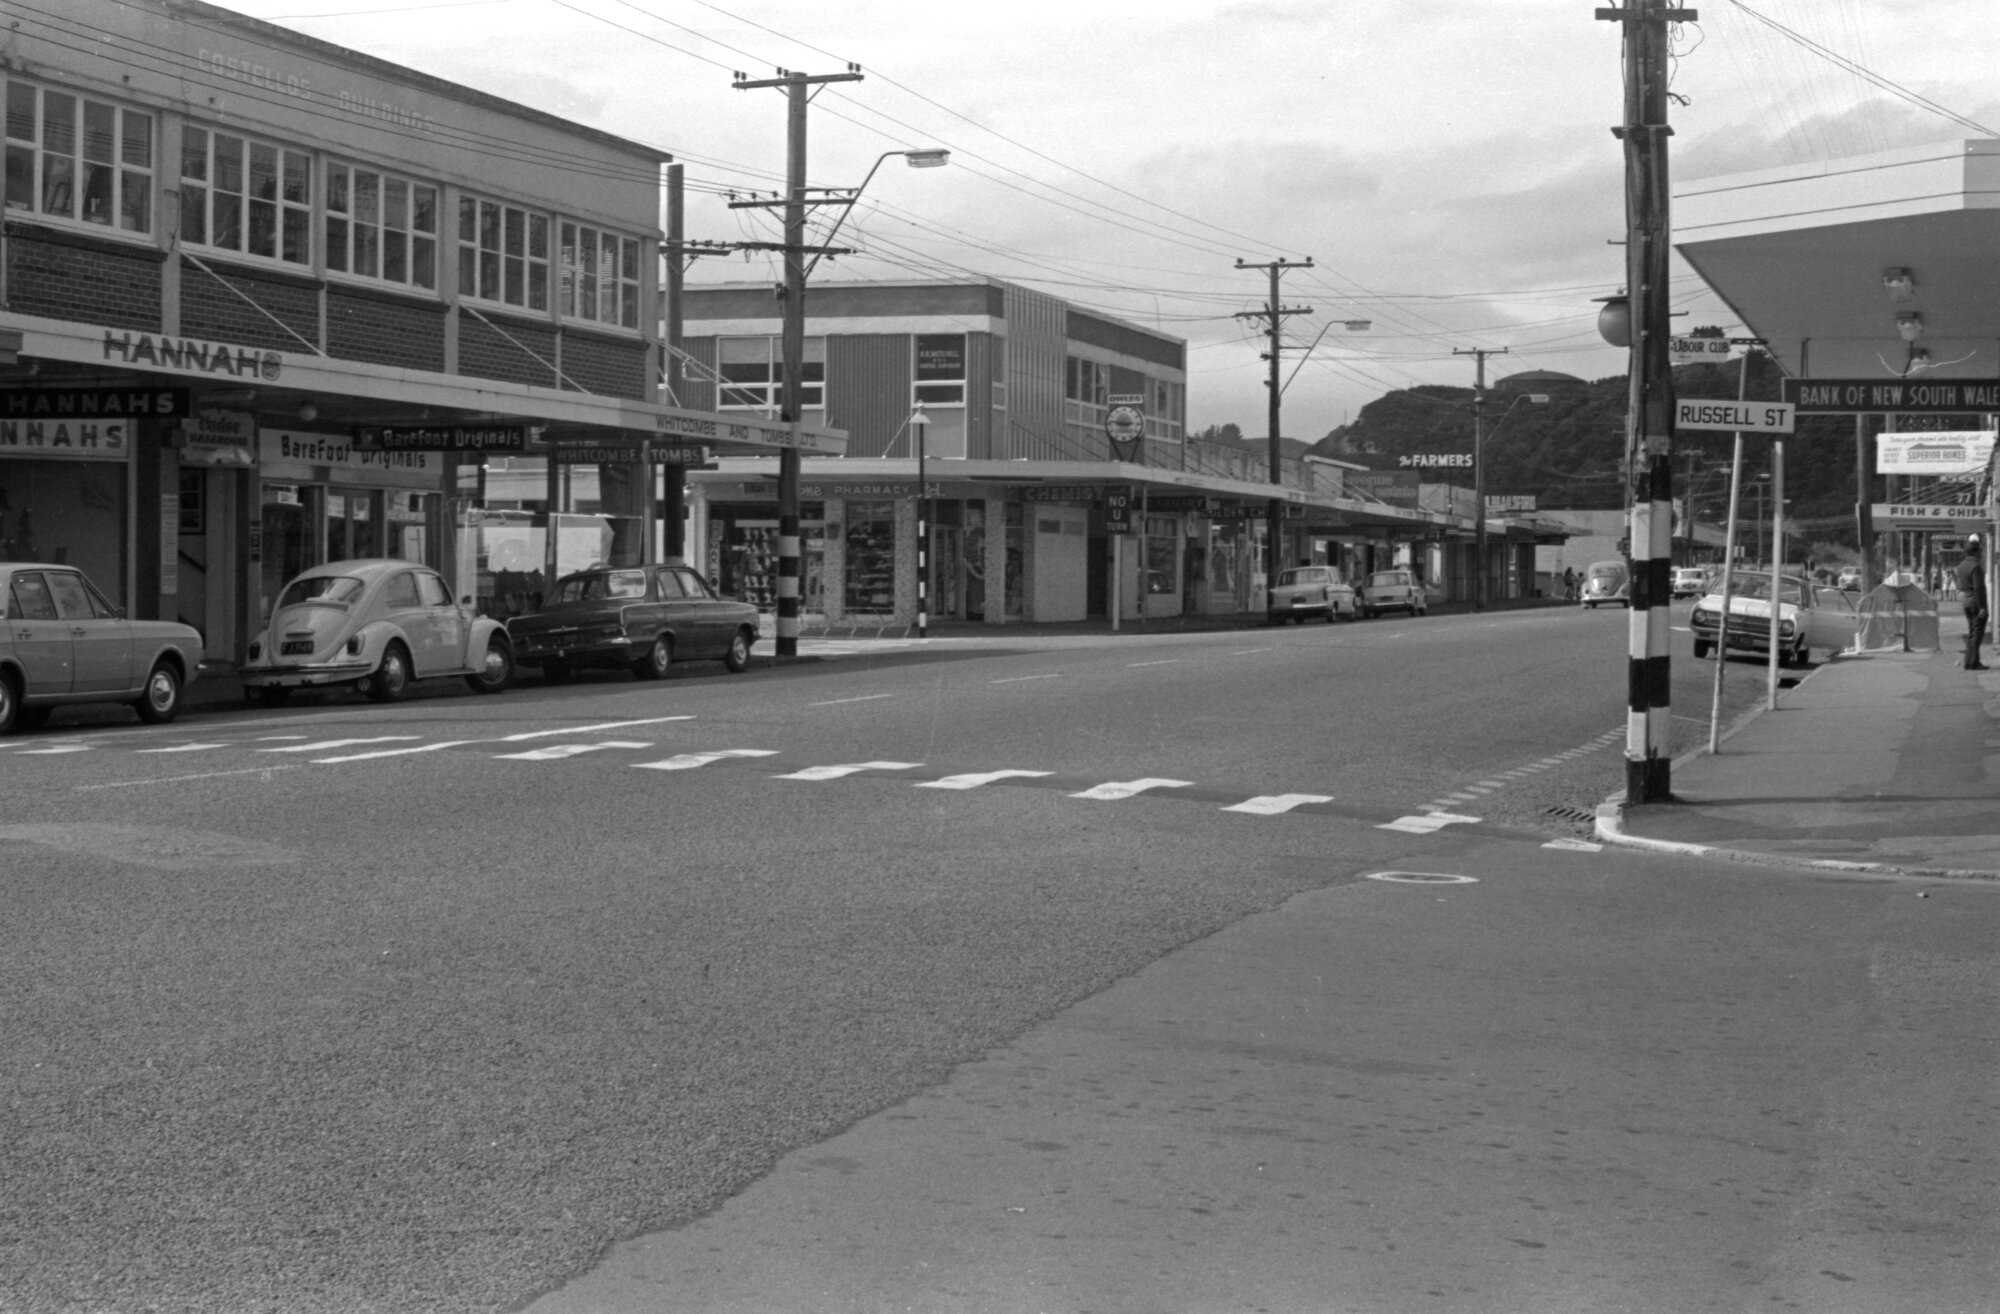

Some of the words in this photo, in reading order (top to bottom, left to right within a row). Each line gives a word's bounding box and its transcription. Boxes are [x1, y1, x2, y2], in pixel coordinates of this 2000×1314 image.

[198, 48, 311, 98] COSTELLO'S
[340, 89, 434, 134] BUILDINGS
[1673, 341, 1704, 353] LABOUR
[1709, 341, 1730, 353] CLUB
[104, 329, 282, 381] HANNAHS
[1800, 386, 1840, 405] BANK
[1846, 386, 1865, 405] OF
[1873, 386, 1903, 405] NEW
[1909, 386, 1956, 405] SOUTH
[1963, 386, 2000, 405] WALE
[8, 392, 174, 414] HANNAHS
[1680, 405, 1755, 425] RUSSELL
[1764, 408, 1787, 426] ST
[655, 415, 717, 436] WHITCOMBE
[728, 425, 749, 440] AND
[760, 429, 791, 445] TOMBS
[455, 429, 521, 447] Originals
[555, 449, 637, 462] WHITCOMBE
[651, 449, 700, 462] TOMBS
[1412, 454, 1473, 467] FARMERS
[1907, 450, 1941, 460] SUPERIOR
[1942, 450, 1966, 460] HOMES
[834, 485, 910, 495] PHARMACY
[1108, 495, 1126, 507] NO
[1112, 509, 1121, 520] U
[1890, 507, 1926, 516] FISH
[1932, 508, 1941, 516] &
[1947, 508, 1987, 518] CHIPS
[1107, 522, 1128, 531] TURN
